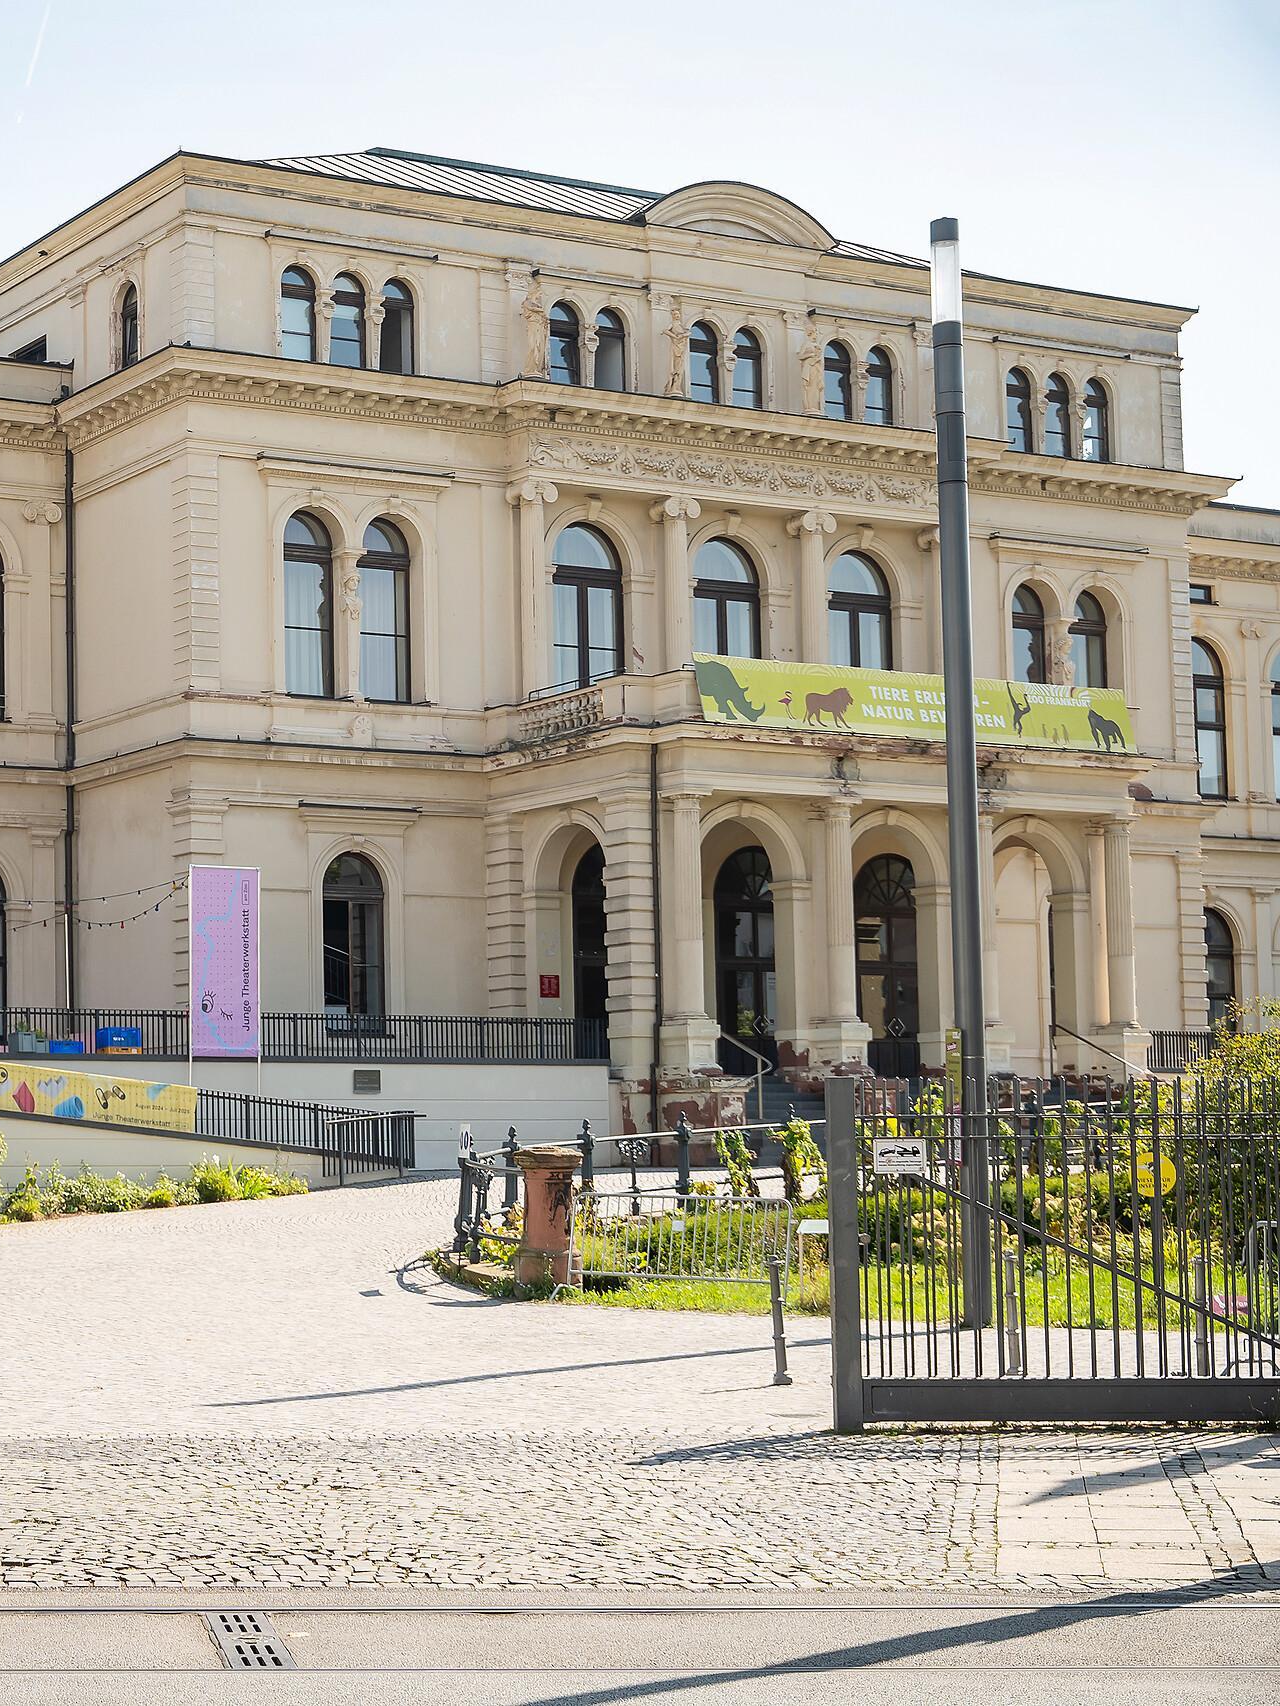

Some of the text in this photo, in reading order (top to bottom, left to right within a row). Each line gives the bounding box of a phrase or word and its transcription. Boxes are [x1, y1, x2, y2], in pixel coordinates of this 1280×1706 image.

[869, 686, 910, 702] TIERE
[1027, 695, 1091, 707] ZOO FRANKFURT
[861, 703, 915, 721] NATUR
[242, 909, 250, 997] Theaterwerkstatt
[242, 1000, 251, 1031] Junge
